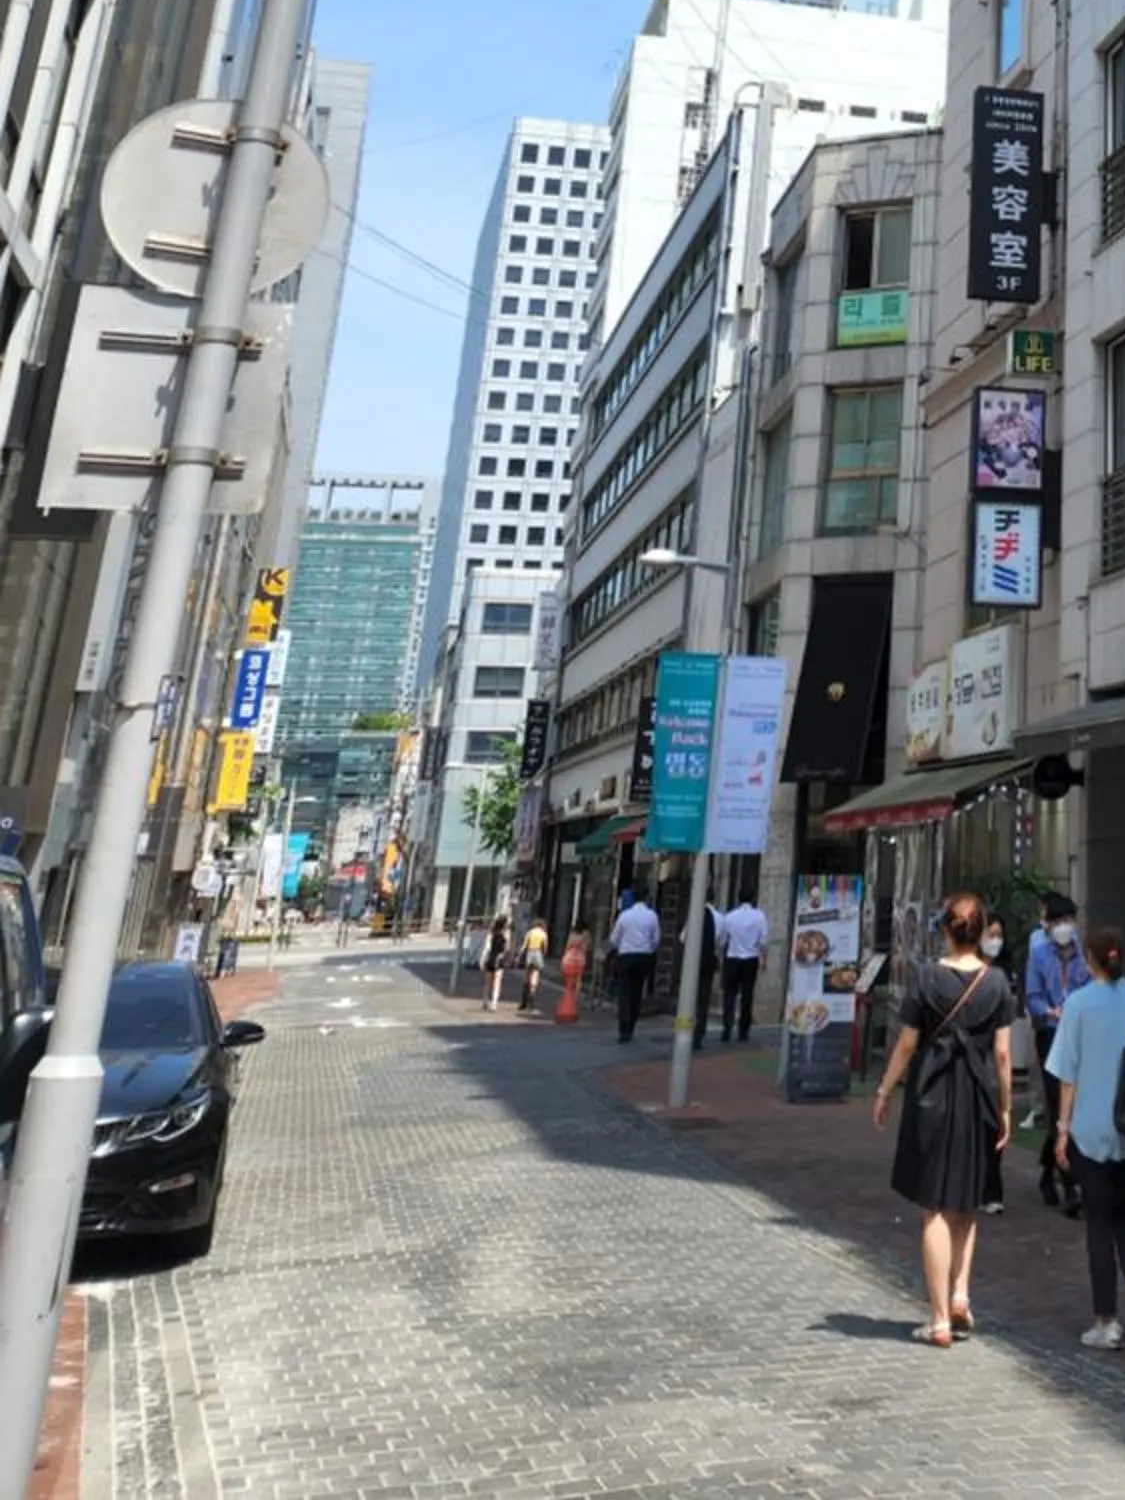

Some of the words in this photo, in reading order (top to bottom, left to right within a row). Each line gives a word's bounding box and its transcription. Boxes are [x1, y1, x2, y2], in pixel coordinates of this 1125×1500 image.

[989, 138, 1031, 270] 美容室
[1014, 356, 1052, 373] LIFE
[993, 509, 1021, 595] チヂミ
